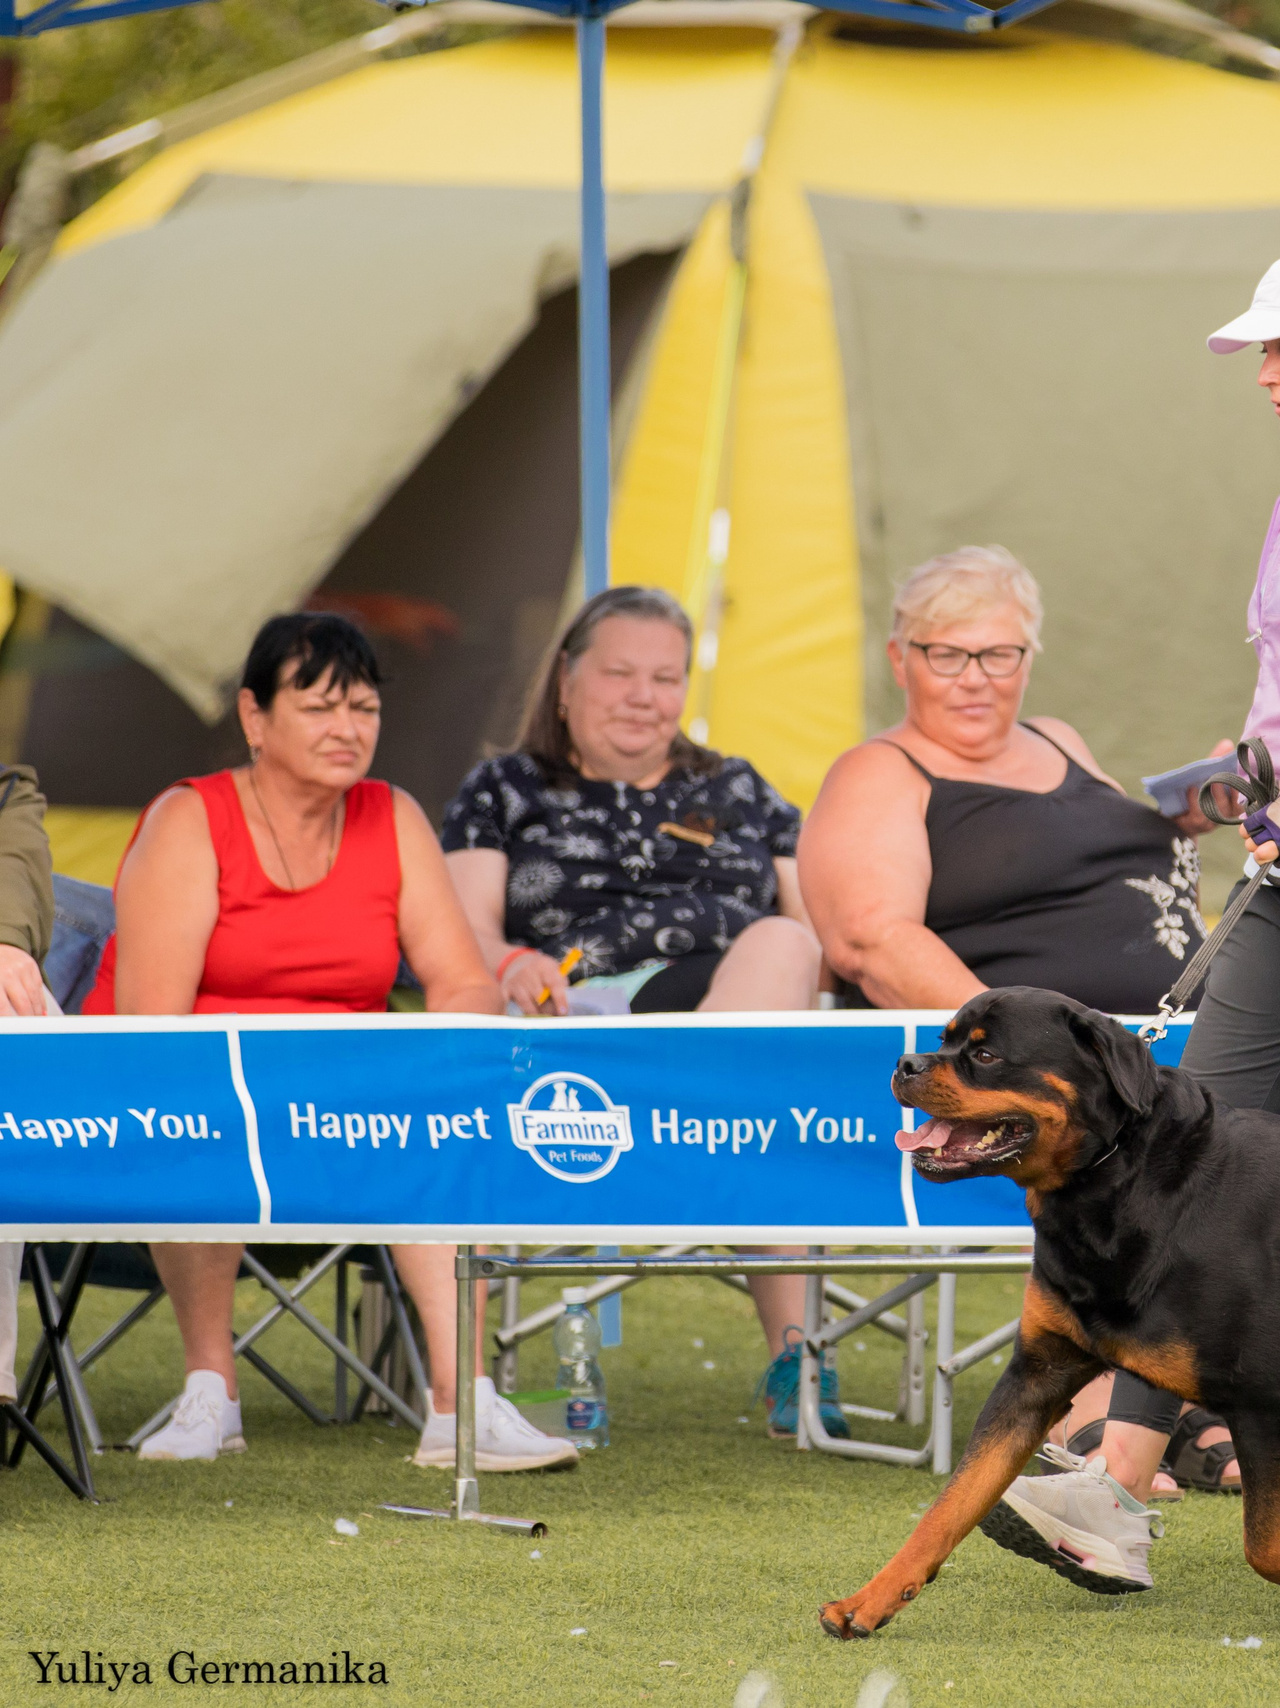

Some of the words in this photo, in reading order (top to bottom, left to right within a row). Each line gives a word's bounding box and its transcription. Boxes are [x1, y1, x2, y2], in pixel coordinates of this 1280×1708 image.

[127, 1108, 221, 1139] You.
[288, 1103, 411, 1149] Happy
[427, 1107, 491, 1149] pet
[521, 1115, 620, 1142] Farmina
[652, 1109, 777, 1154] Happy
[790, 1107, 876, 1143] You.
[549, 1150, 567, 1163] Pet
[570, 1149, 603, 1163] Foods
